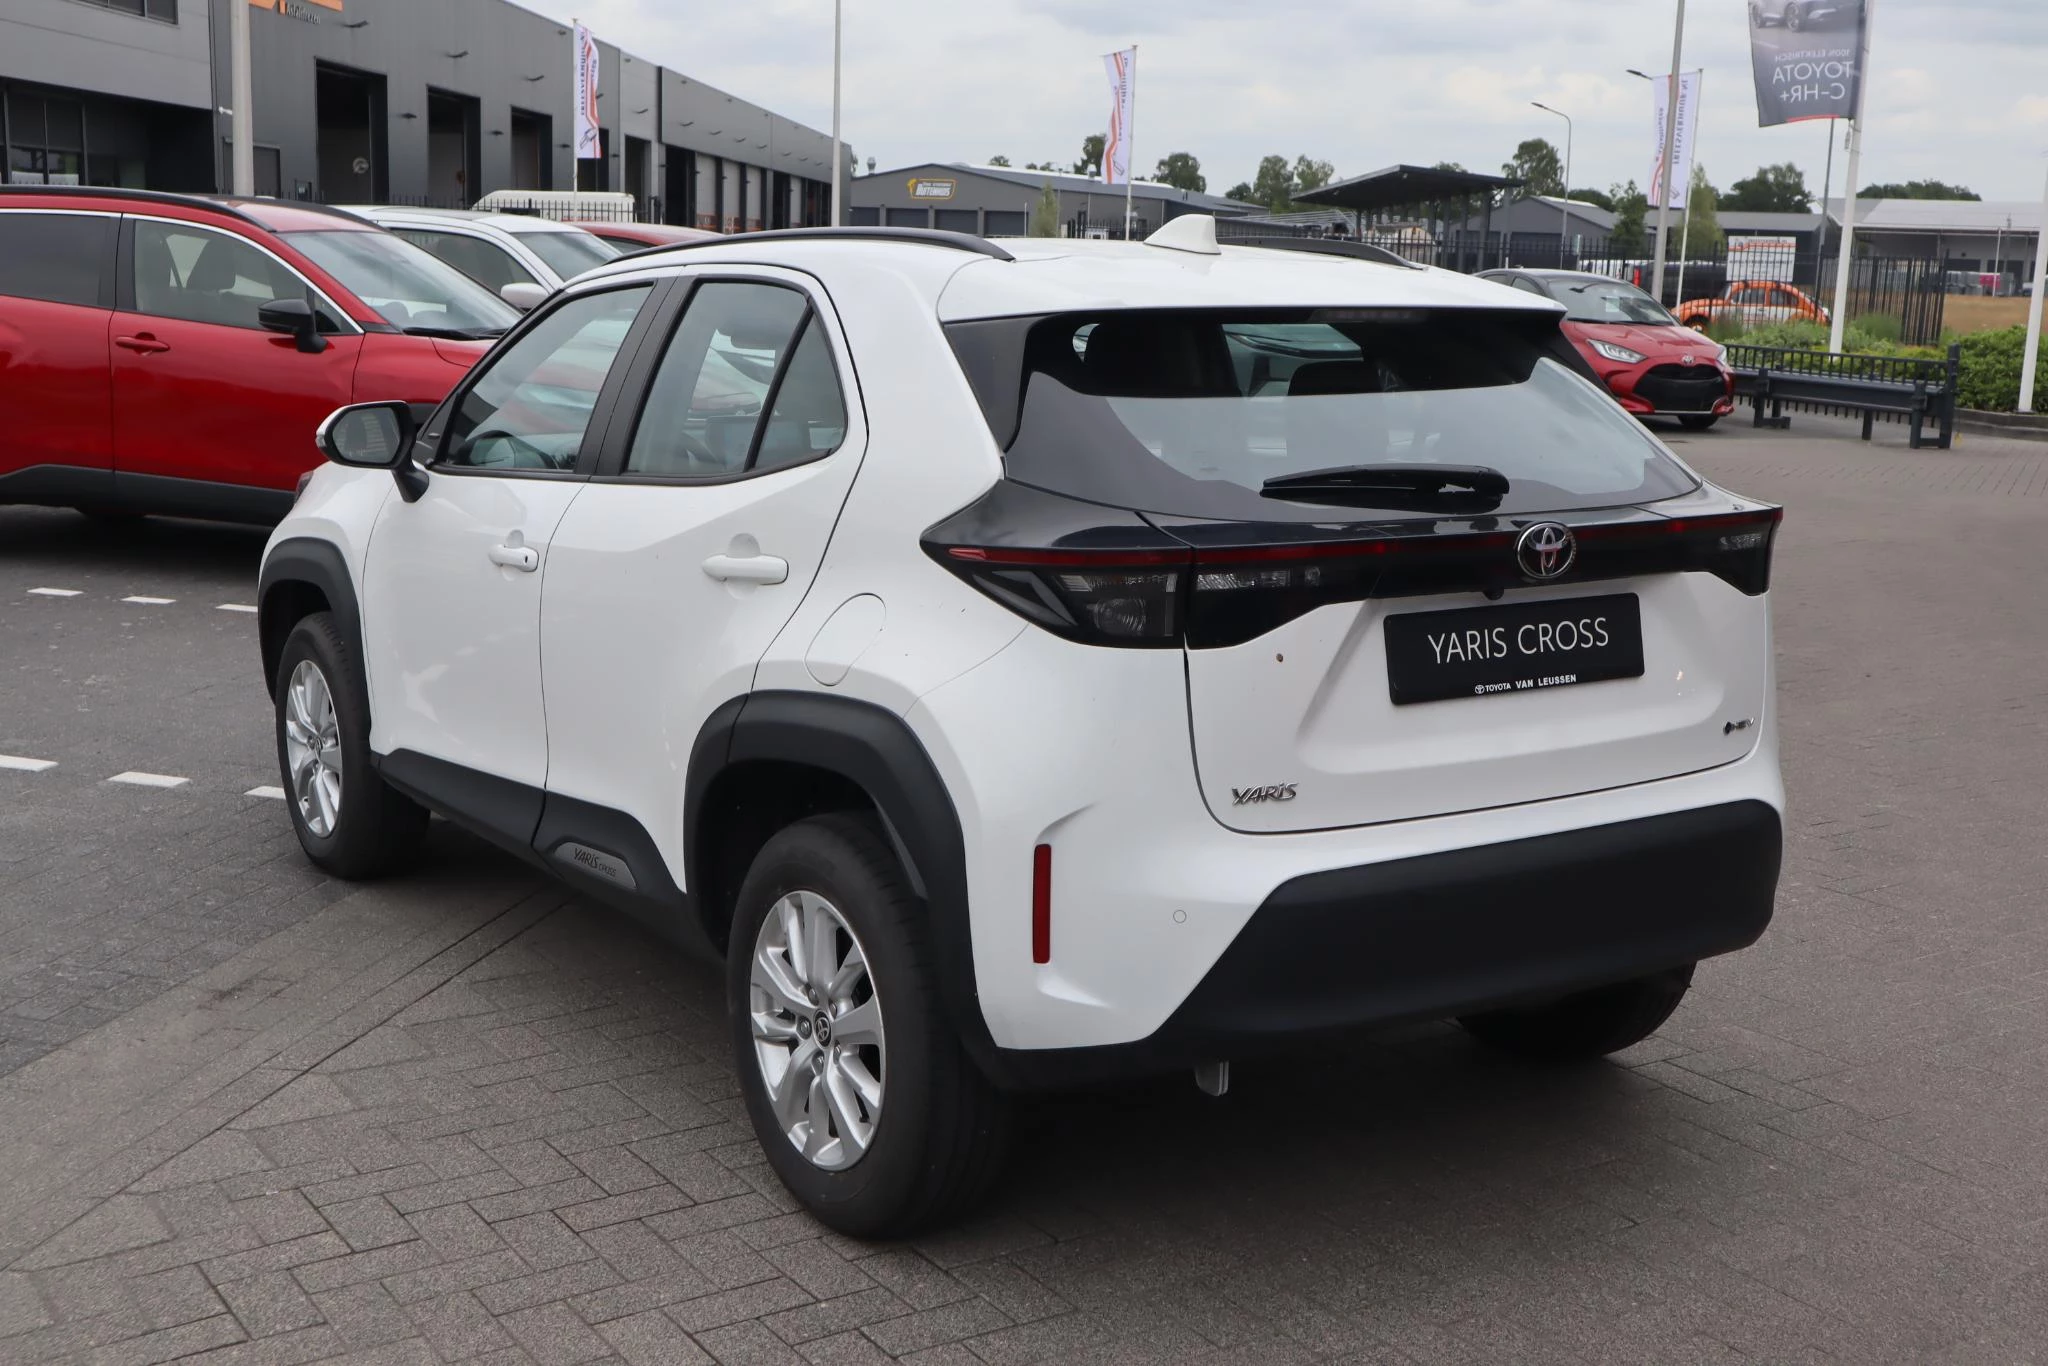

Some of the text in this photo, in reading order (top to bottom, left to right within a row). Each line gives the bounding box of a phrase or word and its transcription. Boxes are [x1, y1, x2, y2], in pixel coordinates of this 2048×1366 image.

[1427, 617, 1609, 664] YARIS CROSS
[1485, 674, 1577, 693] TOYOTA VAN LEUSSEN
